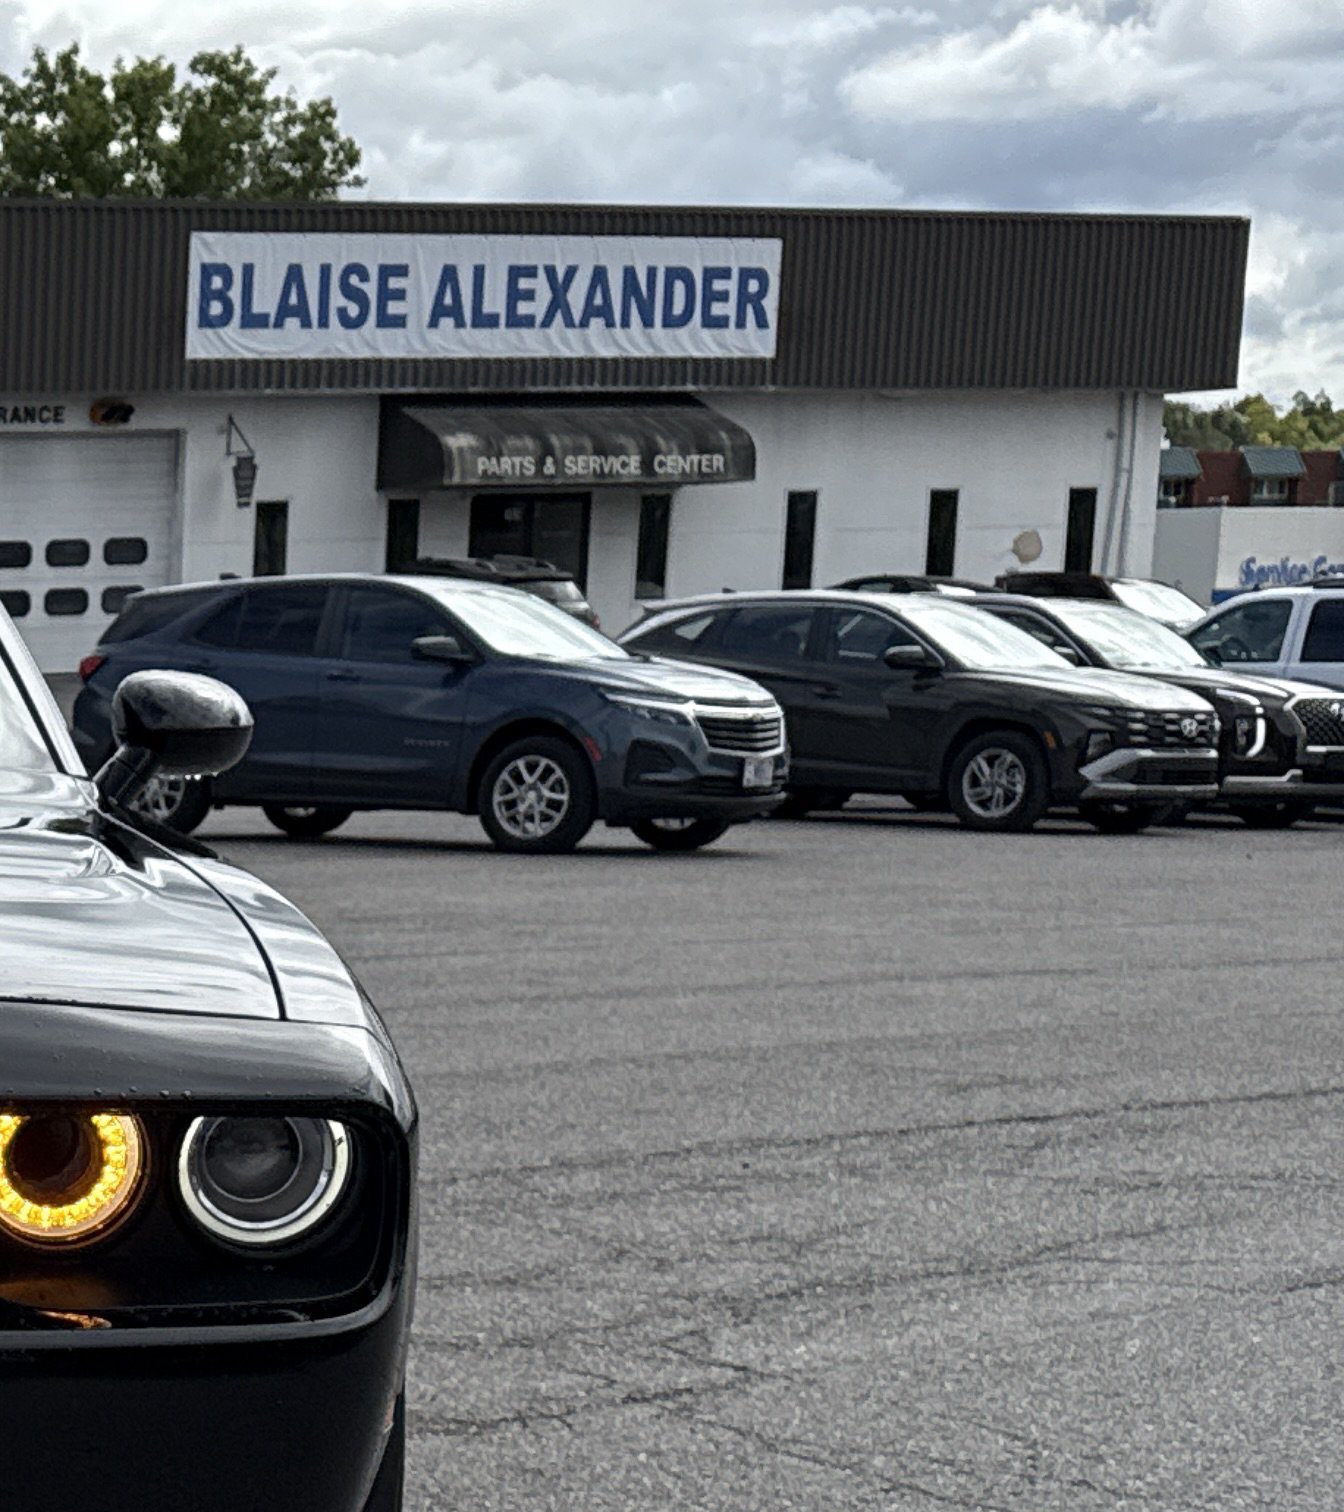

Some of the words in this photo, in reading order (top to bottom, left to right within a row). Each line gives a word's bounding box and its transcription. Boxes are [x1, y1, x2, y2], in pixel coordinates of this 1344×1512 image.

[197, 262, 409, 329] BLAISE
[427, 264, 770, 330] ALEXANDER
[477, 456, 536, 476] PARTS
[543, 457, 556, 476] &
[564, 455, 642, 475] SERVICE
[653, 454, 725, 474] CENTER
